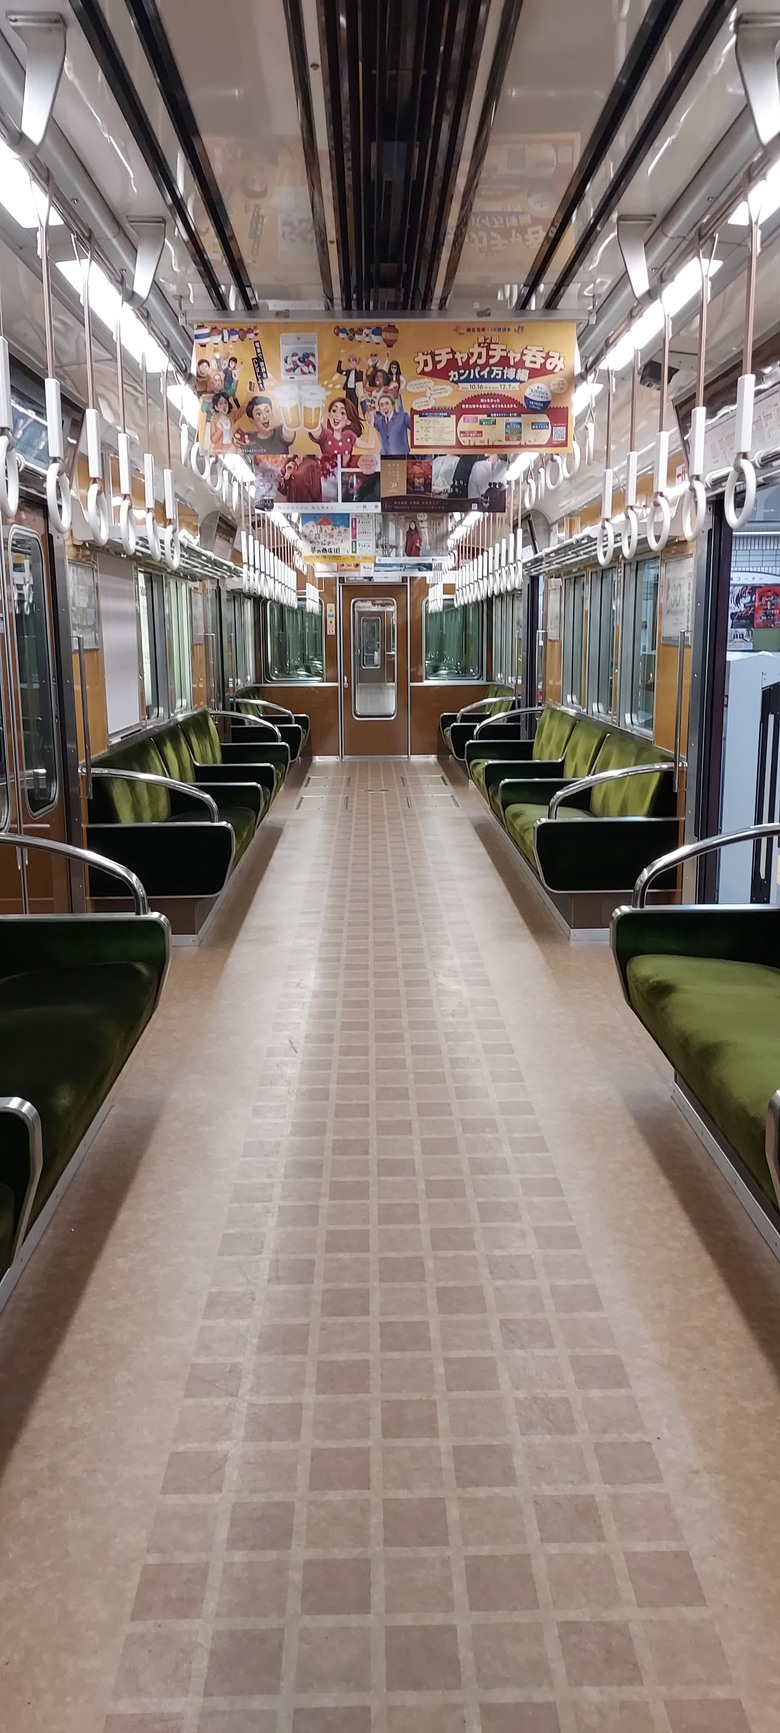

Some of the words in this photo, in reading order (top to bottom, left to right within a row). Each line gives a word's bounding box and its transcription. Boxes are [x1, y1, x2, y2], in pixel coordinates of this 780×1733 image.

[414, 344, 565, 373] ガチャガチャ呑み
[448, 366, 530, 382] カンパイ万博編
